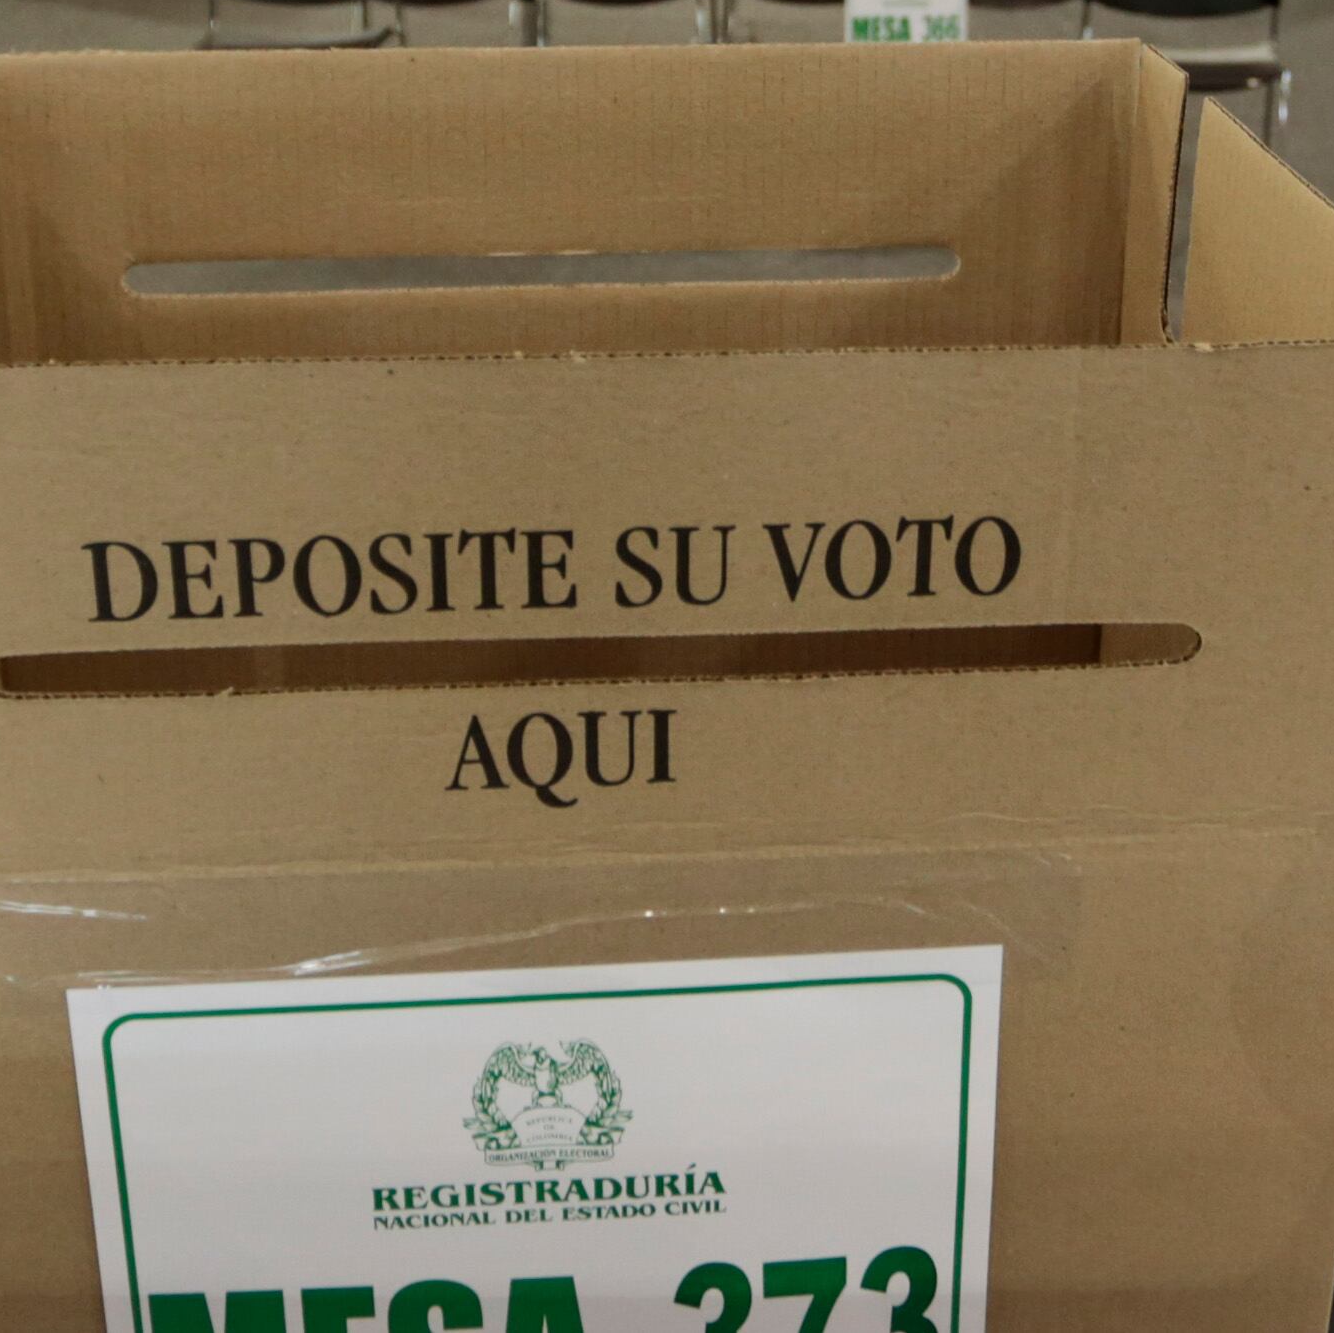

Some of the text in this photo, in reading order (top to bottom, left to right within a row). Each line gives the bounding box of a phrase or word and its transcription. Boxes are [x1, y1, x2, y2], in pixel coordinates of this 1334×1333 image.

[852, 15, 910, 42] MESA
[80, 515, 1023, 623] DEPOSITE SU VOTO
[444, 709, 678, 810] AQUI
[488, 1146, 610, 1163] ORGANIZACIÓN ELECTORAL
[372, 1162, 727, 1211] REGISTRADURÍA
[373, 1199, 727, 1232] NACIONAL DEL ESTADO CIVIL
